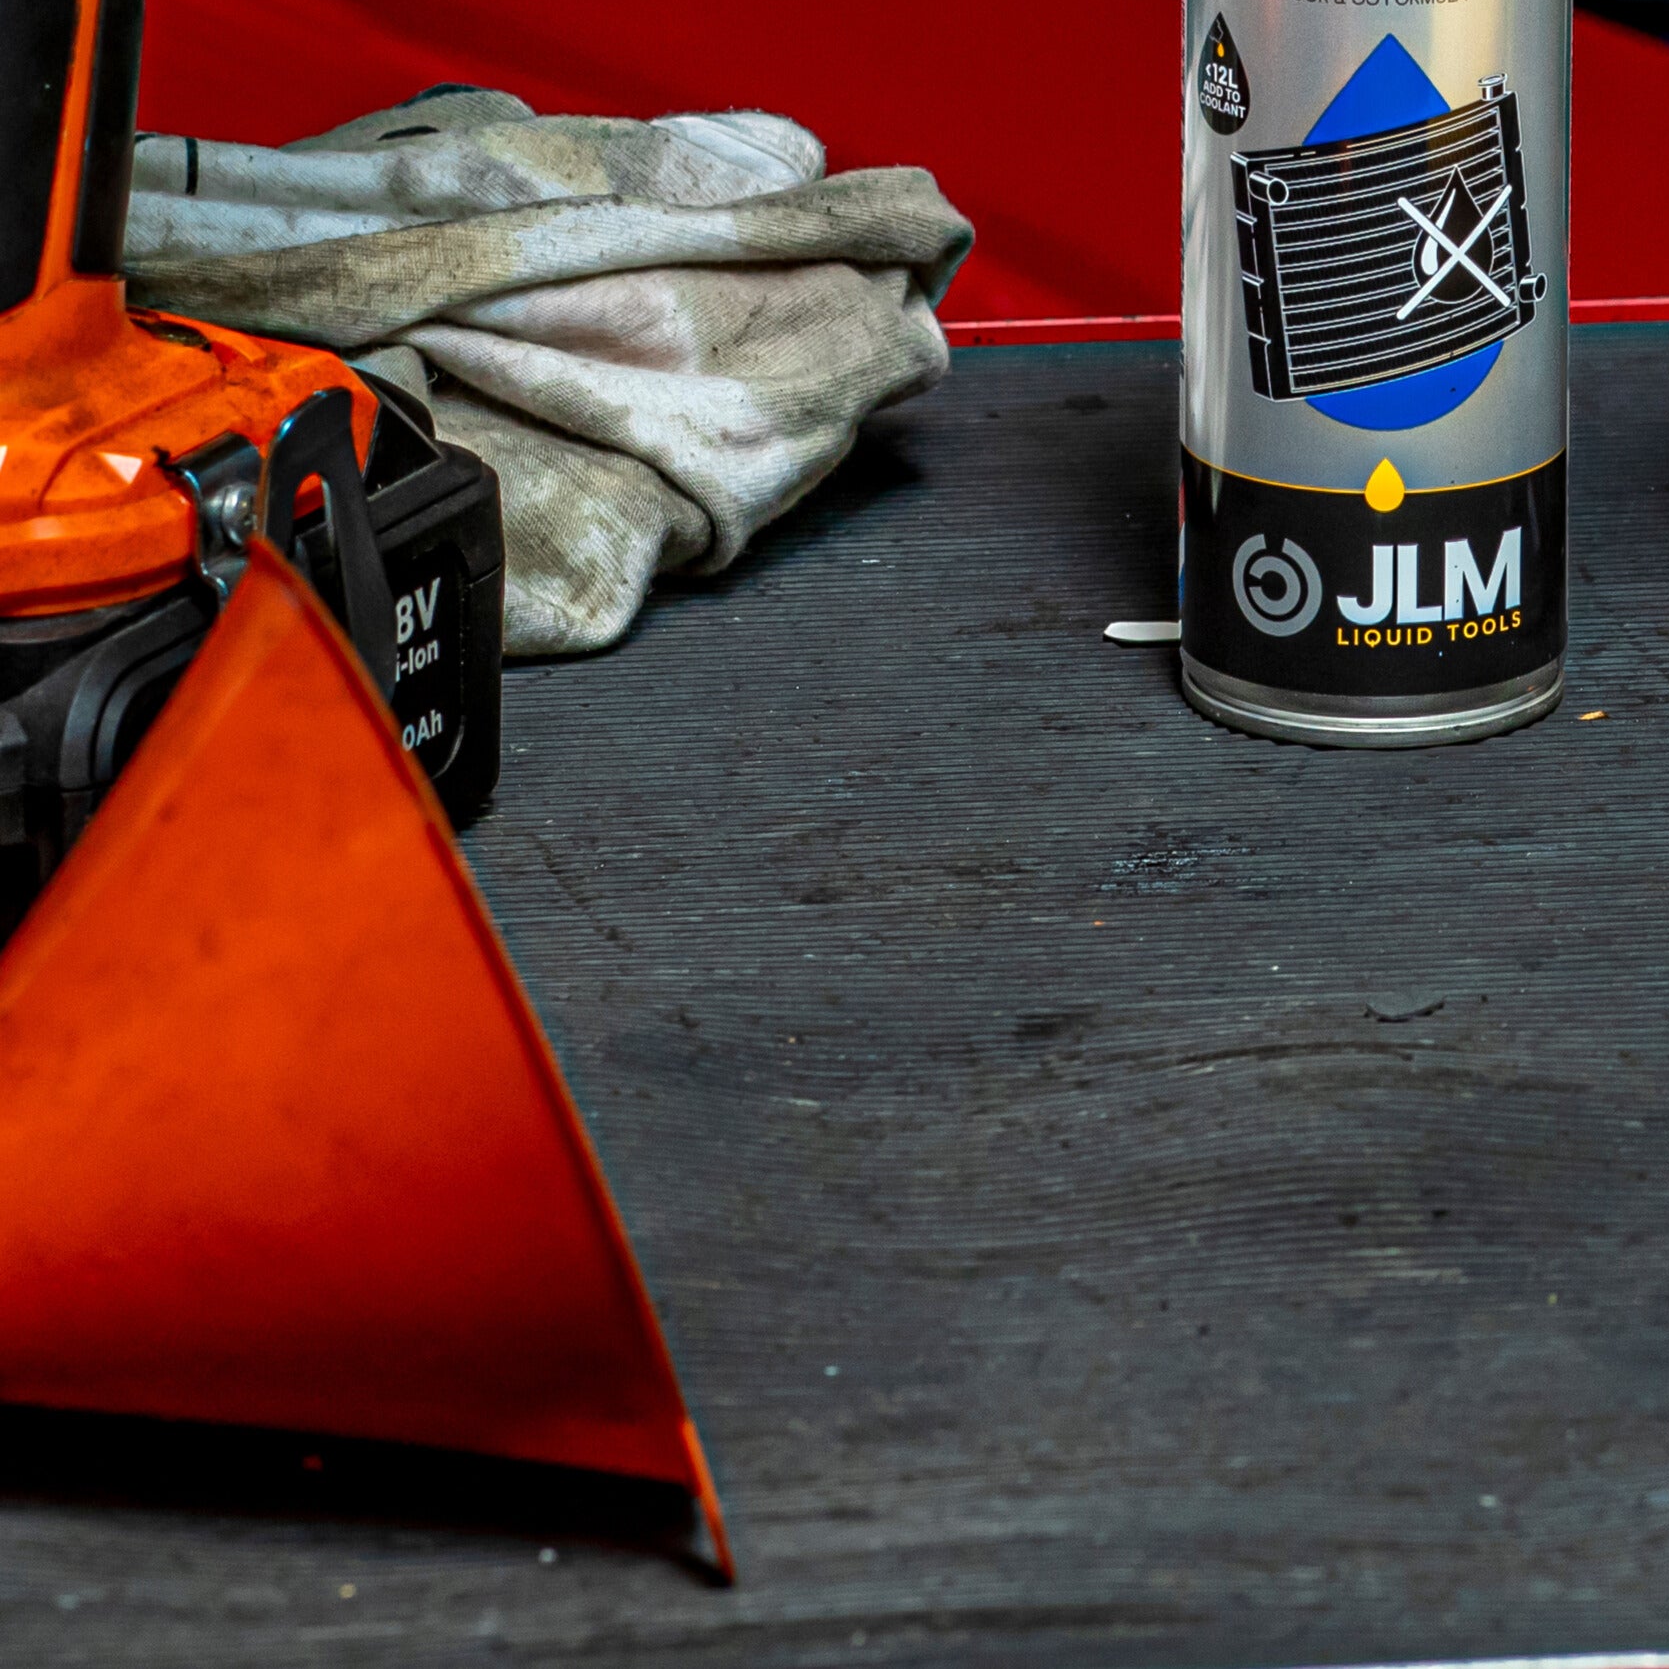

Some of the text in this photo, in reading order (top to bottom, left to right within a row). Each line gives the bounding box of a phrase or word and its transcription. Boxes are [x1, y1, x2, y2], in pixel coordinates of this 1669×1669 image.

[1200, 92, 1246, 118] COOLANT
[1203, 80, 1240, 103] ADD TO
[1336, 526, 1522, 625] JLM
[395, 577, 440, 644] 8V
[1337, 611, 1521, 648] LIQUID TOOLS
[395, 639, 439, 682] i-Ion
[402, 709, 443, 751] 0Ah
